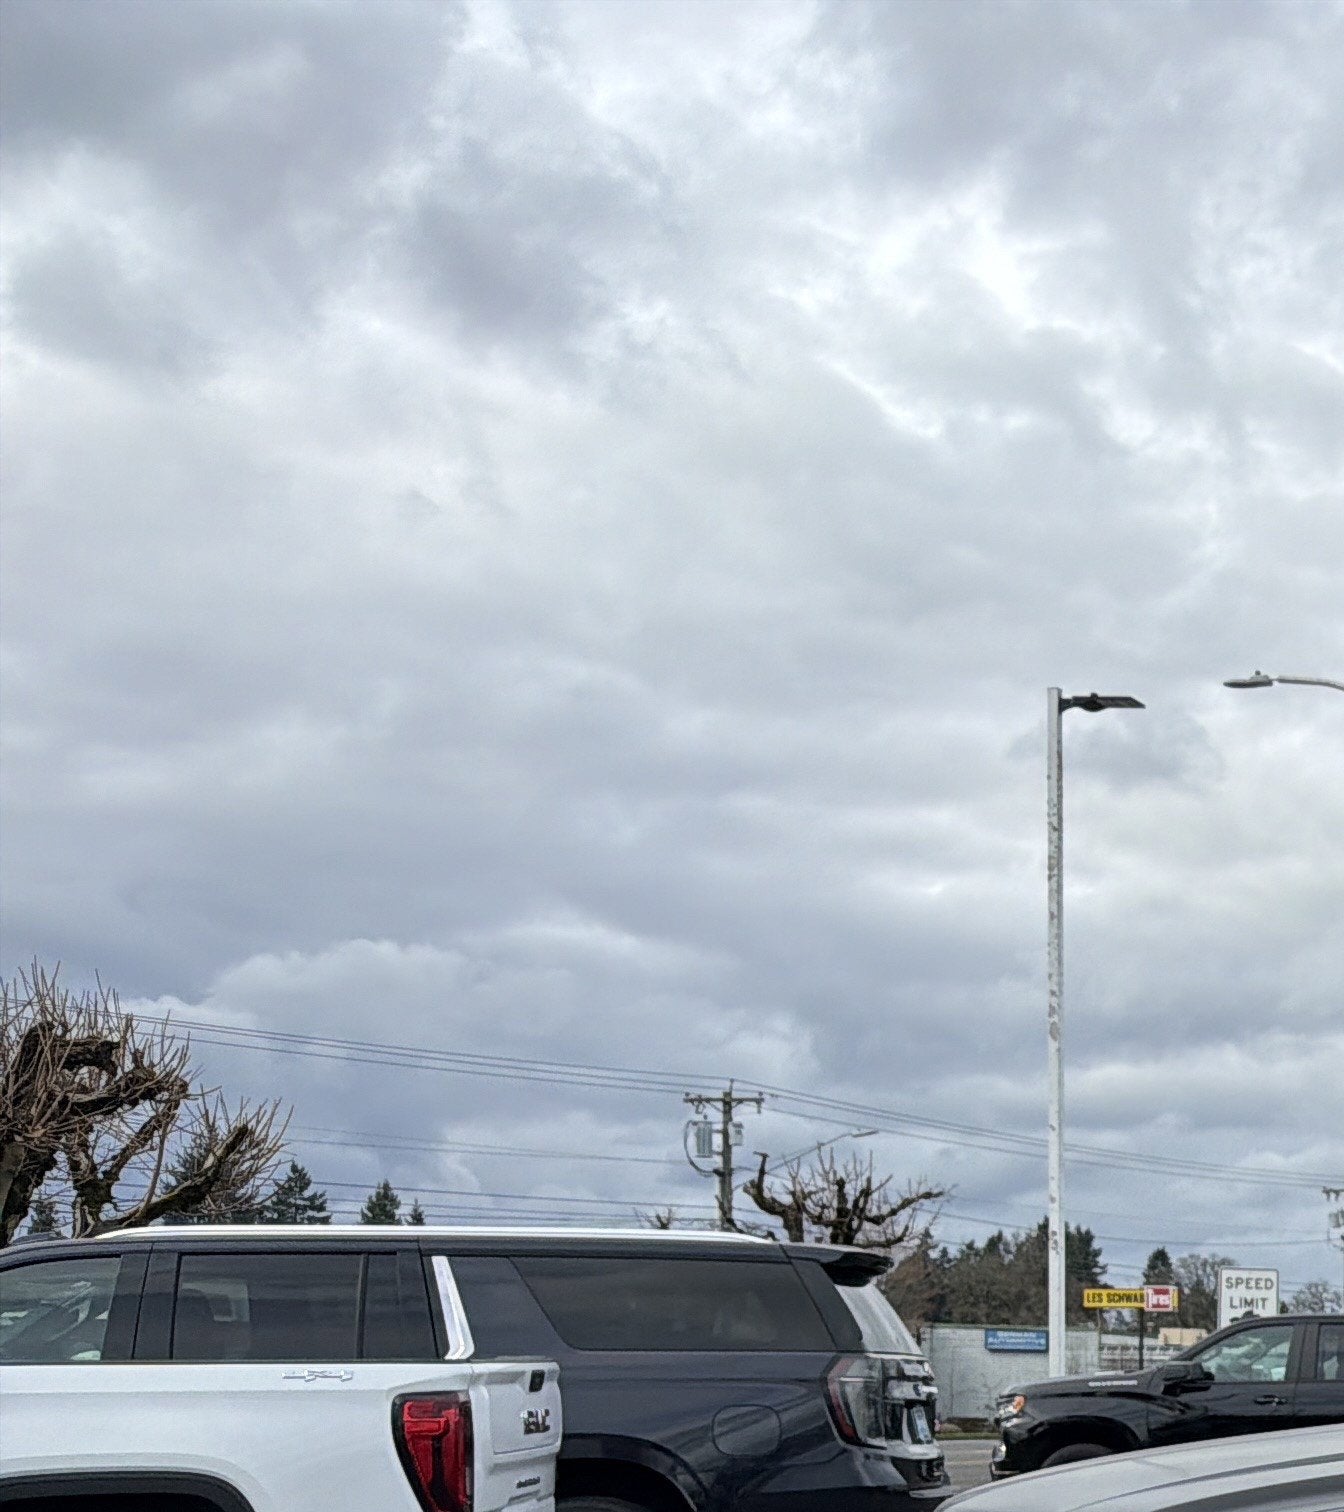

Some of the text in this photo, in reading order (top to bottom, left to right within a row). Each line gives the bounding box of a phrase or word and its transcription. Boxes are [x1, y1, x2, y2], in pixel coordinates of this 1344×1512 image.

[1225, 1276, 1274, 1290] SPEED
[1086, 1292, 1103, 1304] LES
[1229, 1296, 1268, 1310] LIMIT
